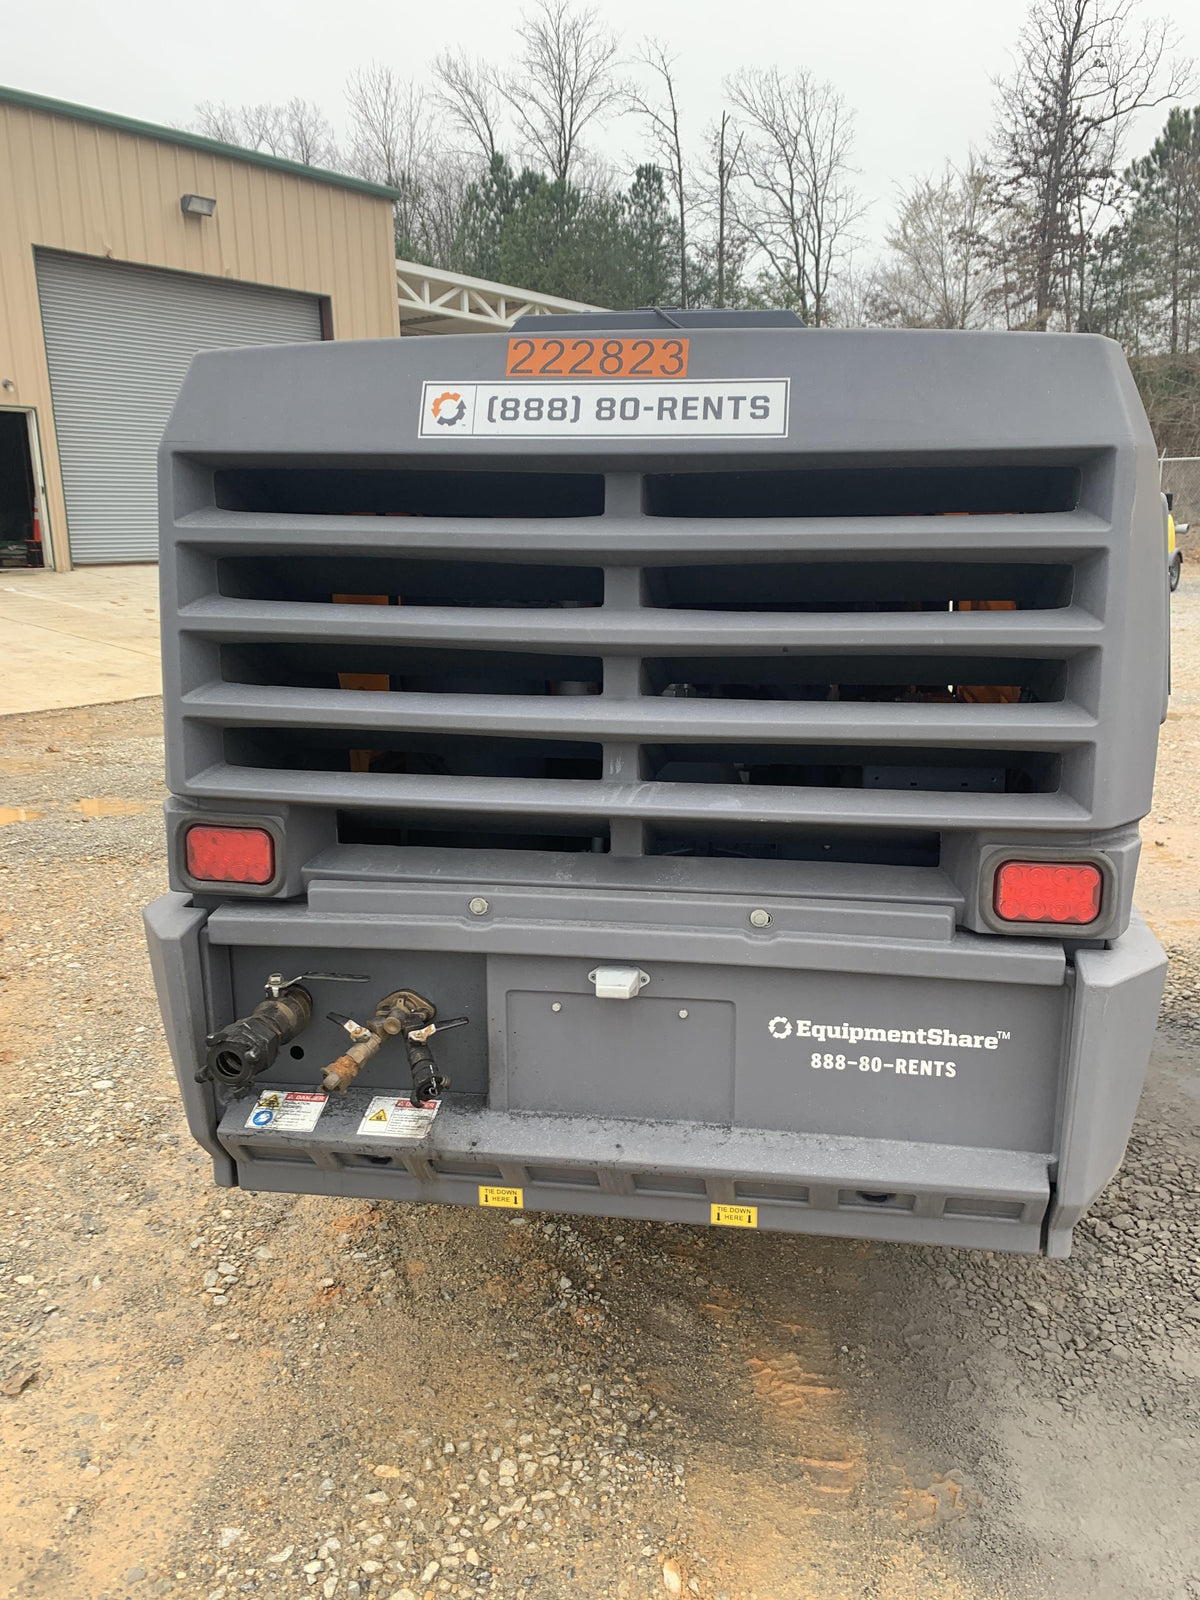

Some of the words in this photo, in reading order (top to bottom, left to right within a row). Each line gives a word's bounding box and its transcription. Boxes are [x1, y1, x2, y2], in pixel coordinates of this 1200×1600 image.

[509, 339, 685, 376] 222823
[486, 395, 581, 423] (888)
[595, 395, 771, 421] 80-RENTS
[810, 1052, 957, 1078] 888-80-RENTS
